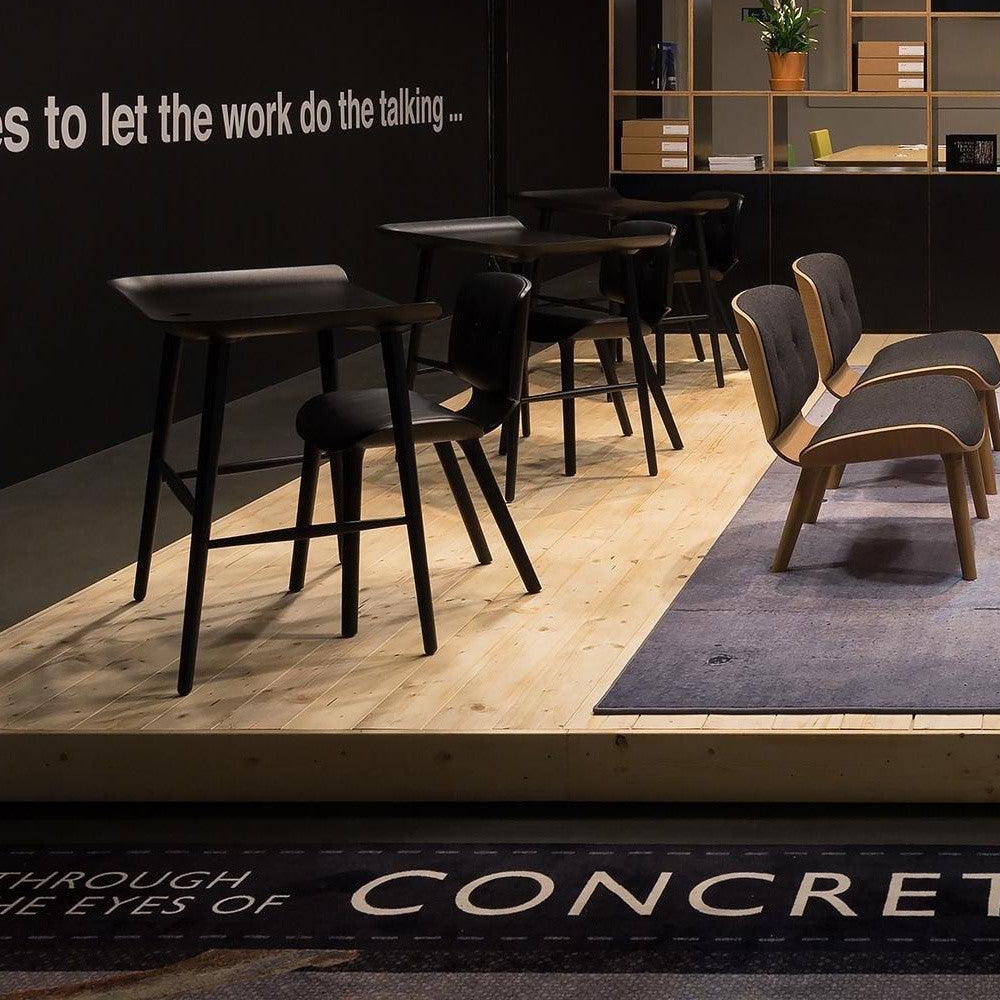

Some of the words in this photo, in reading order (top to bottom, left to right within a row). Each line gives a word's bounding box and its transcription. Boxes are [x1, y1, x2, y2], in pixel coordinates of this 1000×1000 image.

[0, 106, 30, 153] s
[44, 95, 87, 150] to
[101, 92, 148, 147] let
[159, 92, 213, 143] the
[221, 91, 293, 140] work
[300, 89, 332, 134] do
[338, 88, 374, 131] the
[379, 86, 444, 133] talking
[65, 896, 195, 916] EYES
[212, 895, 291, 915] OF
